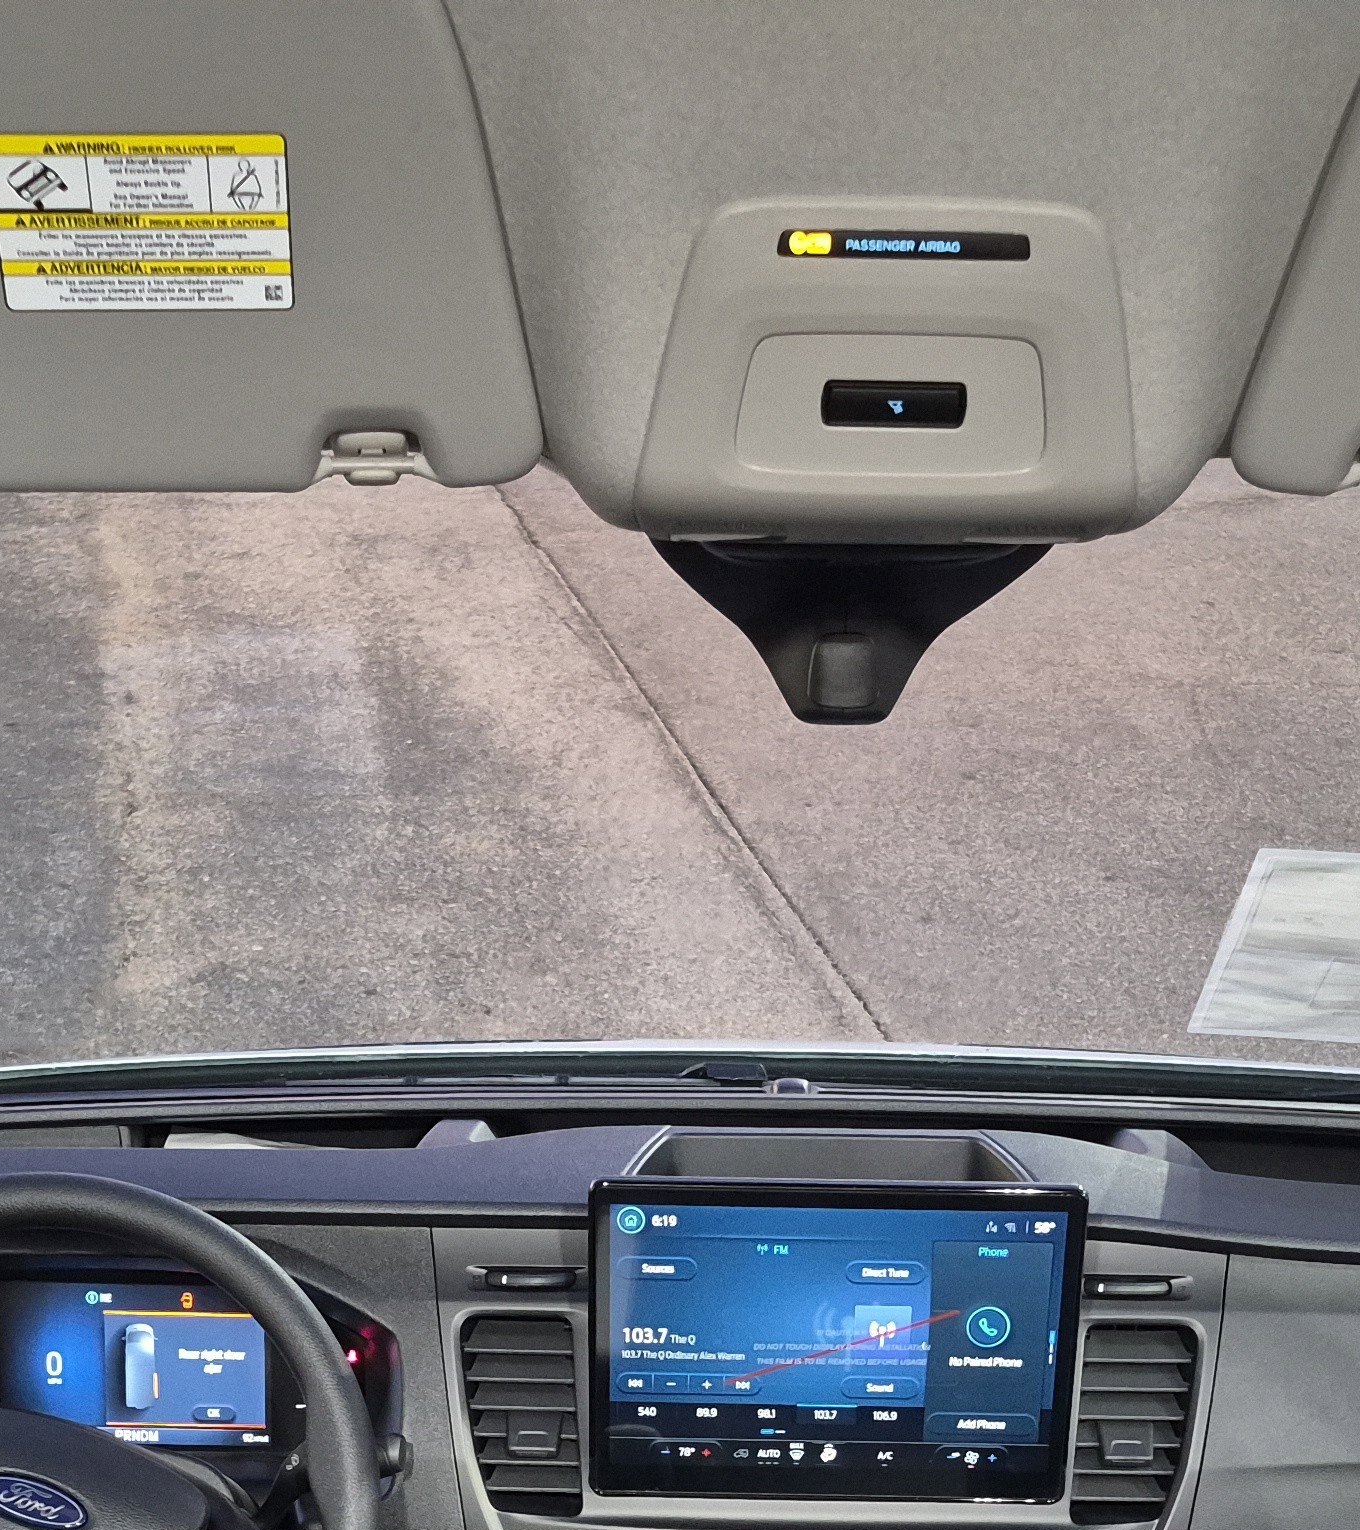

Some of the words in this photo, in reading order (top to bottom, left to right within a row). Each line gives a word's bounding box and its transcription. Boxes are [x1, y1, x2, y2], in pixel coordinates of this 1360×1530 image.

[845, 238, 915, 253] PASSENGER
[918, 240, 961, 253] AIRBAG
[651, 1214, 678, 1227] 6:19
[773, 1245, 789, 1255] FM
[978, 1246, 1009, 1257] Phone
[861, 1267, 886, 1278] Direct
[888, 1267, 910, 1278] Tune
[622, 1327, 668, 1344] 103.7
[669, 1333, 687, 1344] The
[688, 1334, 696, 1345] Q
[621, 1349, 641, 1359] 103.7
[643, 1350, 657, 1359] The
[665, 1350, 698, 1361] Ordinary
[45, 1351, 63, 1376] 0
[949, 1356, 962, 1367] No
[963, 1356, 992, 1367] Paired
[993, 1357, 1023, 1368] Phone
[637, 1406, 657, 1417] 540
[696, 1407, 718, 1418] 89.9
[813, 1410, 838, 1420] 103.7
[873, 1411, 897, 1421] 106.9
[957, 1419, 976, 1429] Add
[977, 1419, 1006, 1430] Phone
[757, 1449, 781, 1458] AUTO
[877, 1451, 893, 1460] A/C
